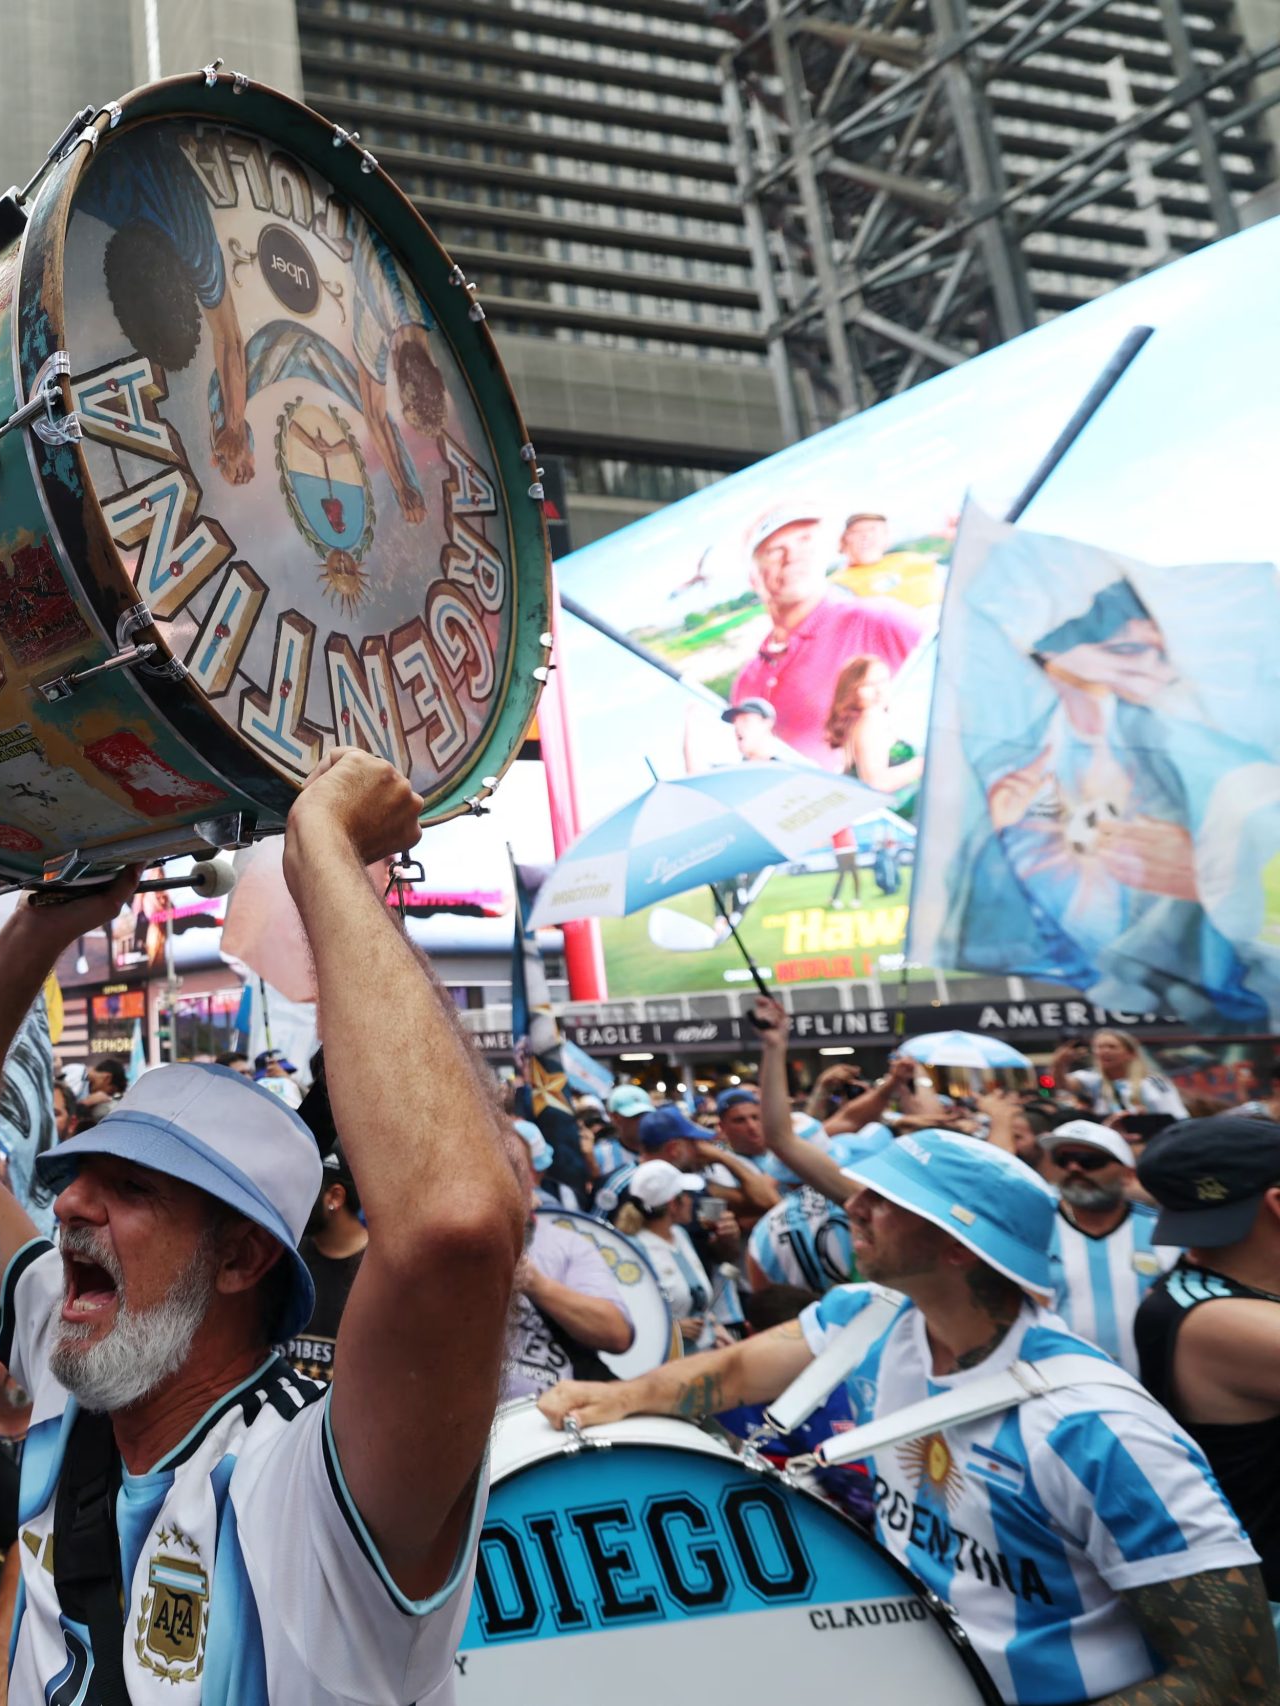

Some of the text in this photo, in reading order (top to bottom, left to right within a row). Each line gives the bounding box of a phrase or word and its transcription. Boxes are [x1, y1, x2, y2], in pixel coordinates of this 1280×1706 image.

[179, 126, 354, 263] TULA
[71, 357, 505, 783] ARGENTINA
[783, 906, 909, 955] Haw
[577, 1025, 644, 1045] EAGLE
[777, 1213, 852, 1293] 10
[288, 1340, 332, 1362] PIBES
[476, 1480, 818, 1644] DIEGO
[873, 1474, 1054, 1606] RGENTINA
[154, 1586, 194, 1646] AFA
[809, 1601, 927, 1632] CLAUDIO
